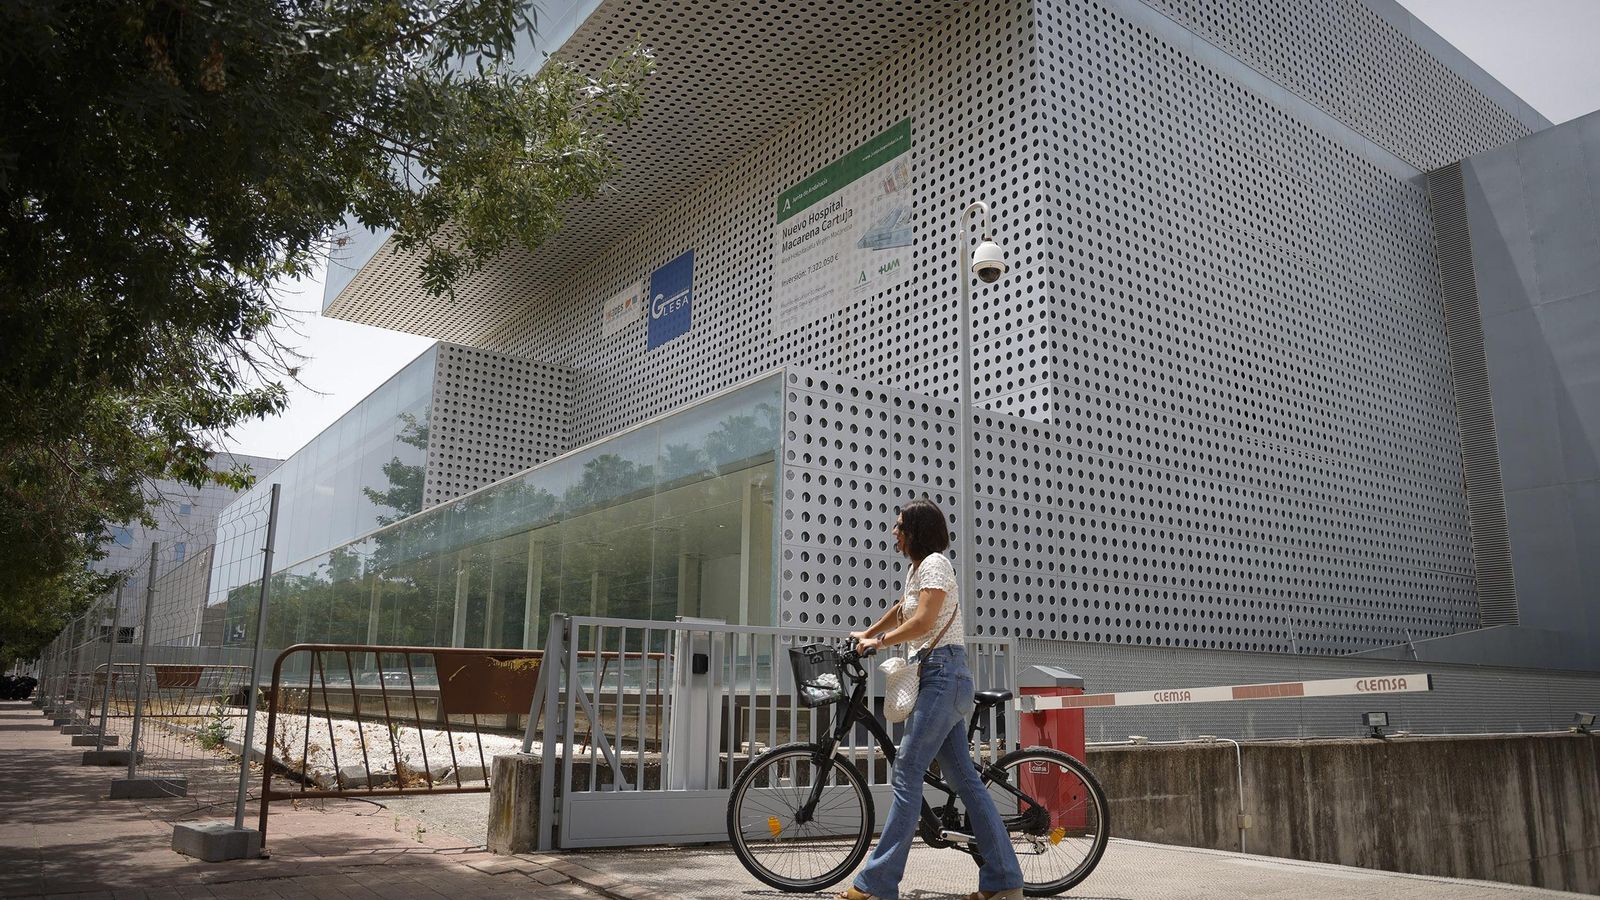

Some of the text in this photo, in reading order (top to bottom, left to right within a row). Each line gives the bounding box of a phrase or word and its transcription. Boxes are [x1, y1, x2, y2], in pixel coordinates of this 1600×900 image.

[782, 196, 843, 239] Nuevo Hospital
[782, 208, 853, 253] Macarena Cartuja
[1153, 690, 1191, 703] CLEMSA
[1356, 678, 1407, 692] CLEMSA
